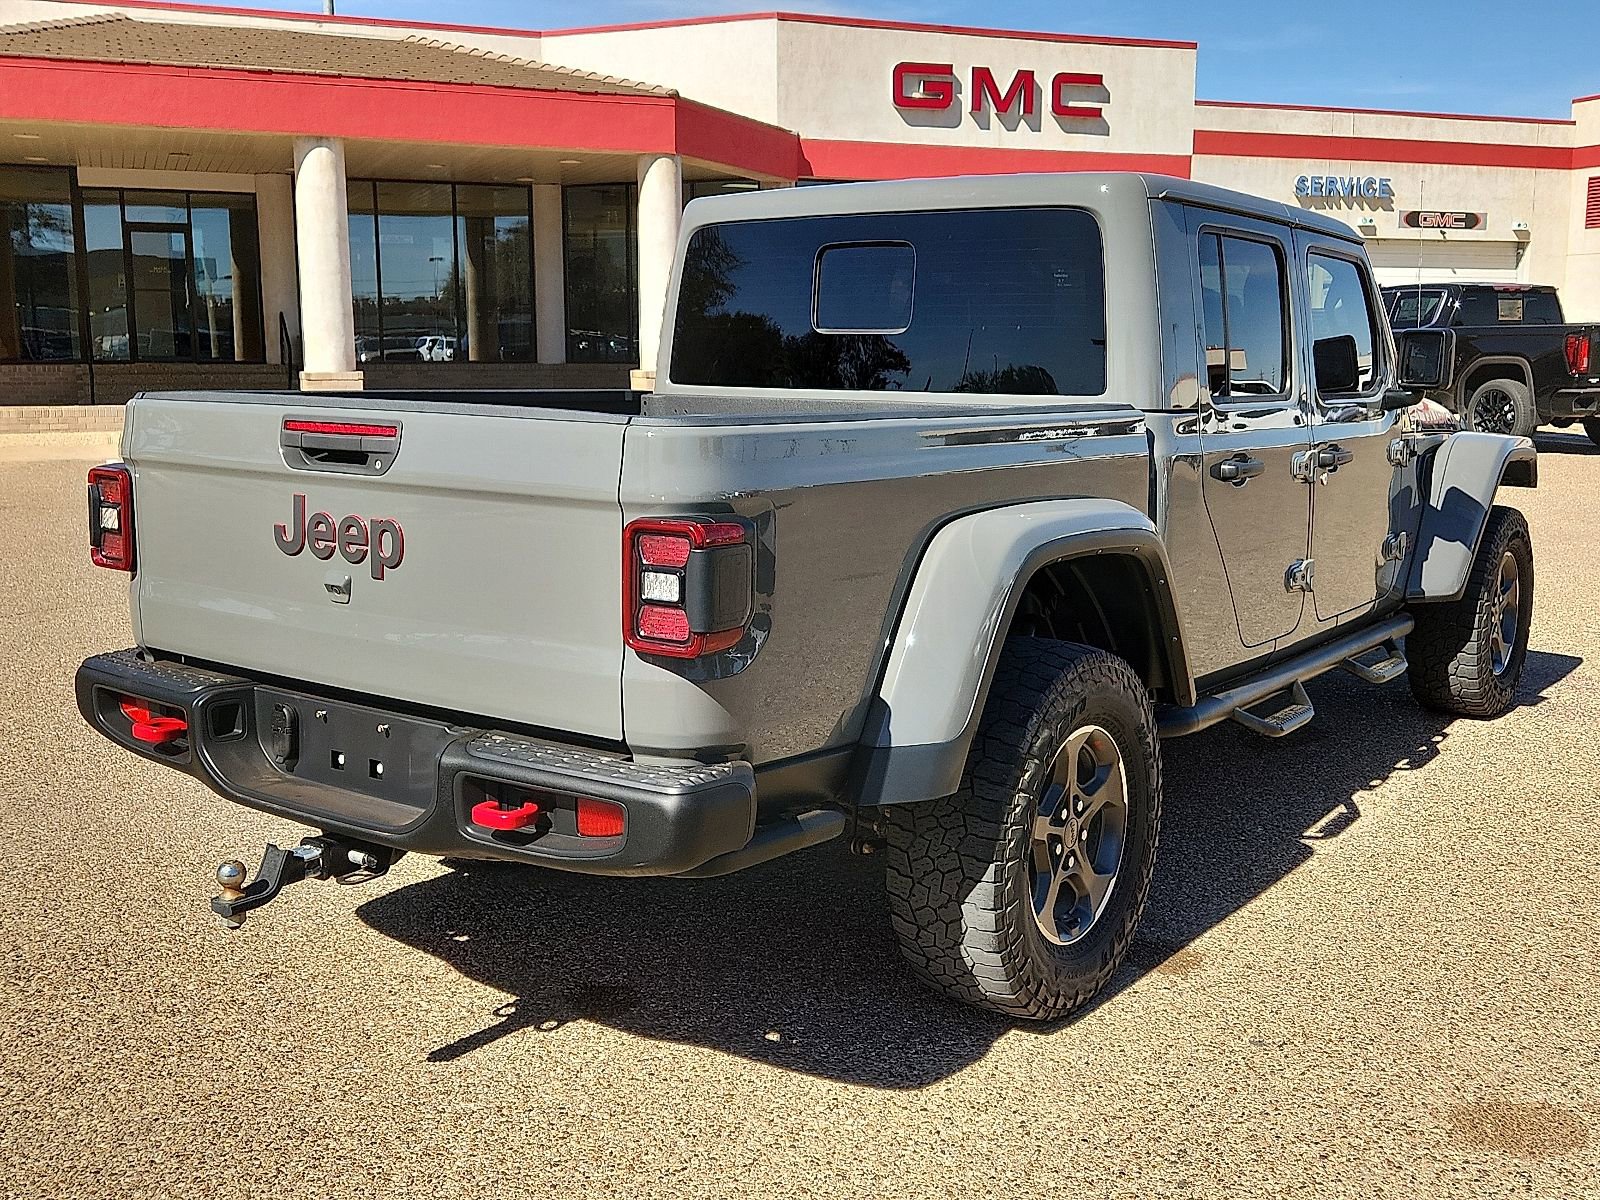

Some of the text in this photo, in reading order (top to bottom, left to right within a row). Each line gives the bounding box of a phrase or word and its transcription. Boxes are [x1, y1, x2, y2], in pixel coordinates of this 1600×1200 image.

[892, 61, 1104, 118] GMC
[1295, 175, 1392, 198] SERVICE
[1418, 212, 1467, 228] GMC
[273, 493, 405, 581] Jeep
